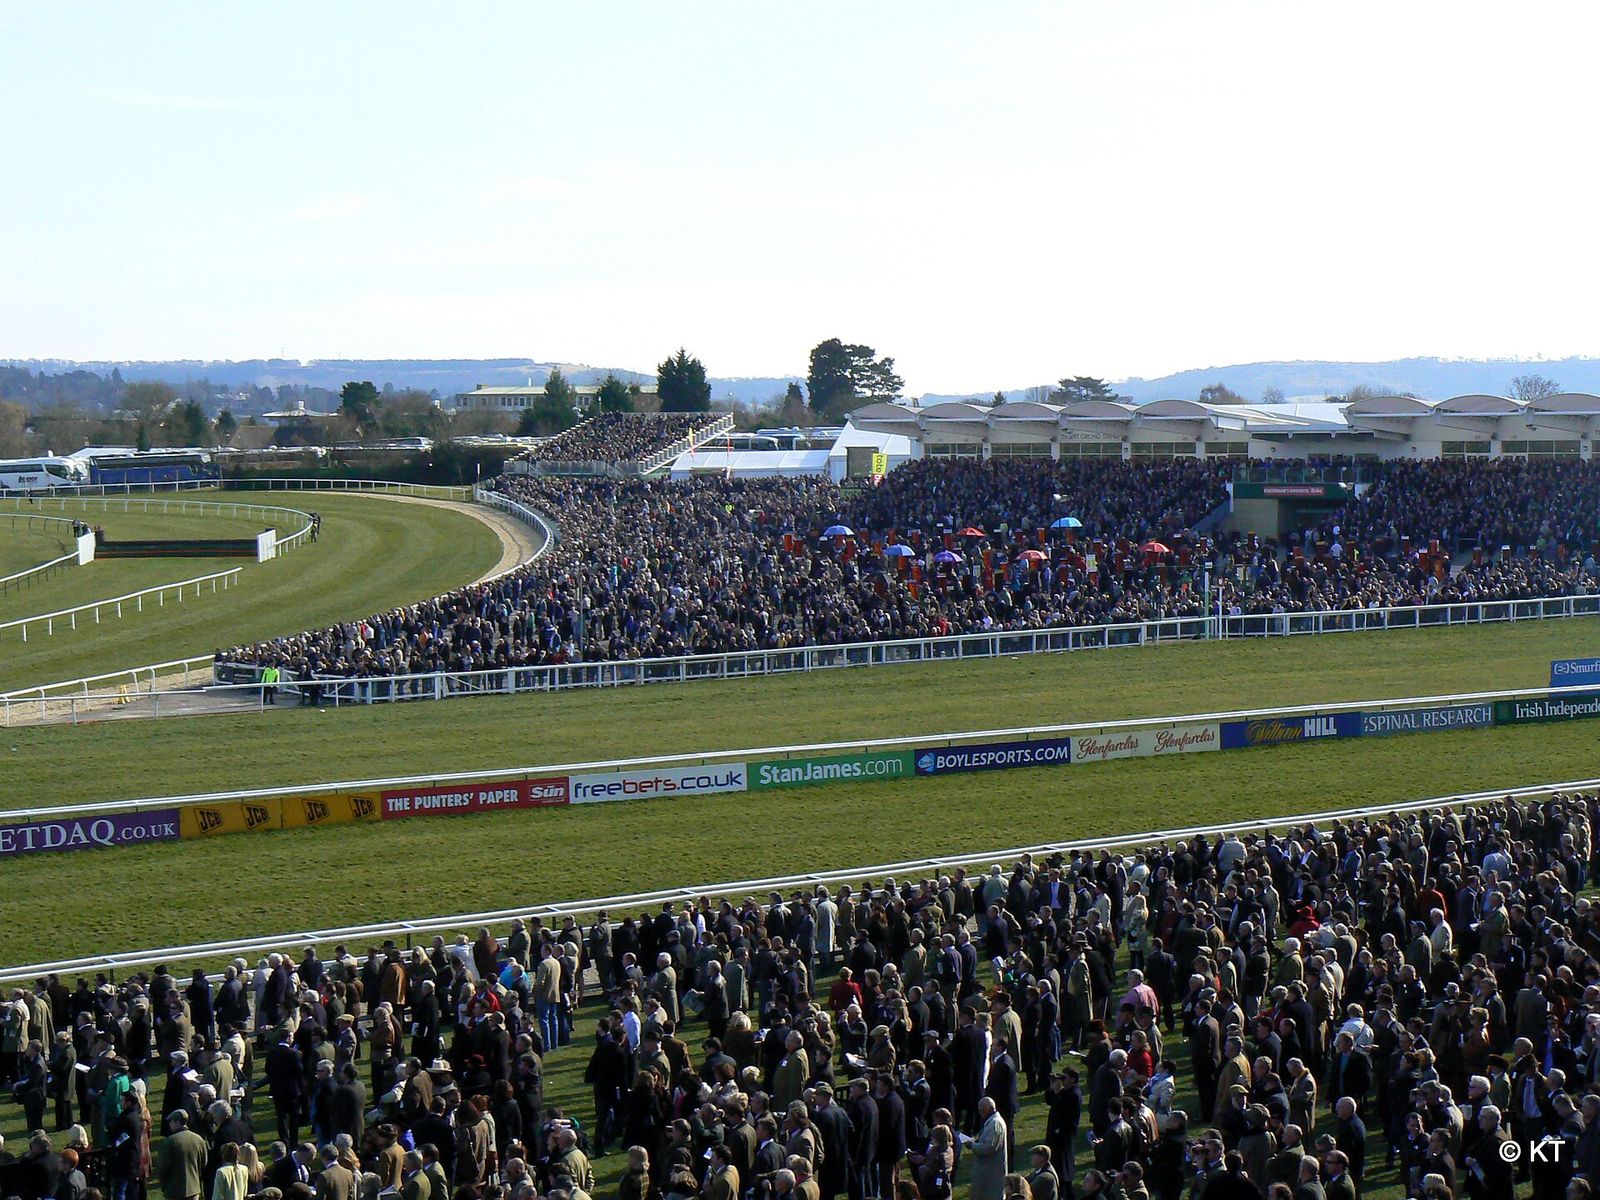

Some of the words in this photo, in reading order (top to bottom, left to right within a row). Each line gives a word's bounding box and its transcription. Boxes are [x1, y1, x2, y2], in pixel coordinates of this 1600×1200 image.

[1422, 707, 1492, 727] RESEARCH
[1515, 702, 1543, 718] Irish
[1303, 716, 1338, 738] HILL
[1076, 735, 1139, 760] Glenfarclas
[1154, 727, 1215, 753] Glenfarclas
[936, 743, 1069, 769] BOYLESPORTS.COM
[759, 758, 903, 785] StanJames.com
[574, 771, 742, 798] freebets.co.uk
[353, 799, 374, 818] JCB
[387, 798, 410, 812] THE
[479, 789, 519, 805] PAPER
[199, 810, 222, 831] JCB
[246, 806, 269, 827] JCB
[306, 802, 328, 822] JCB
